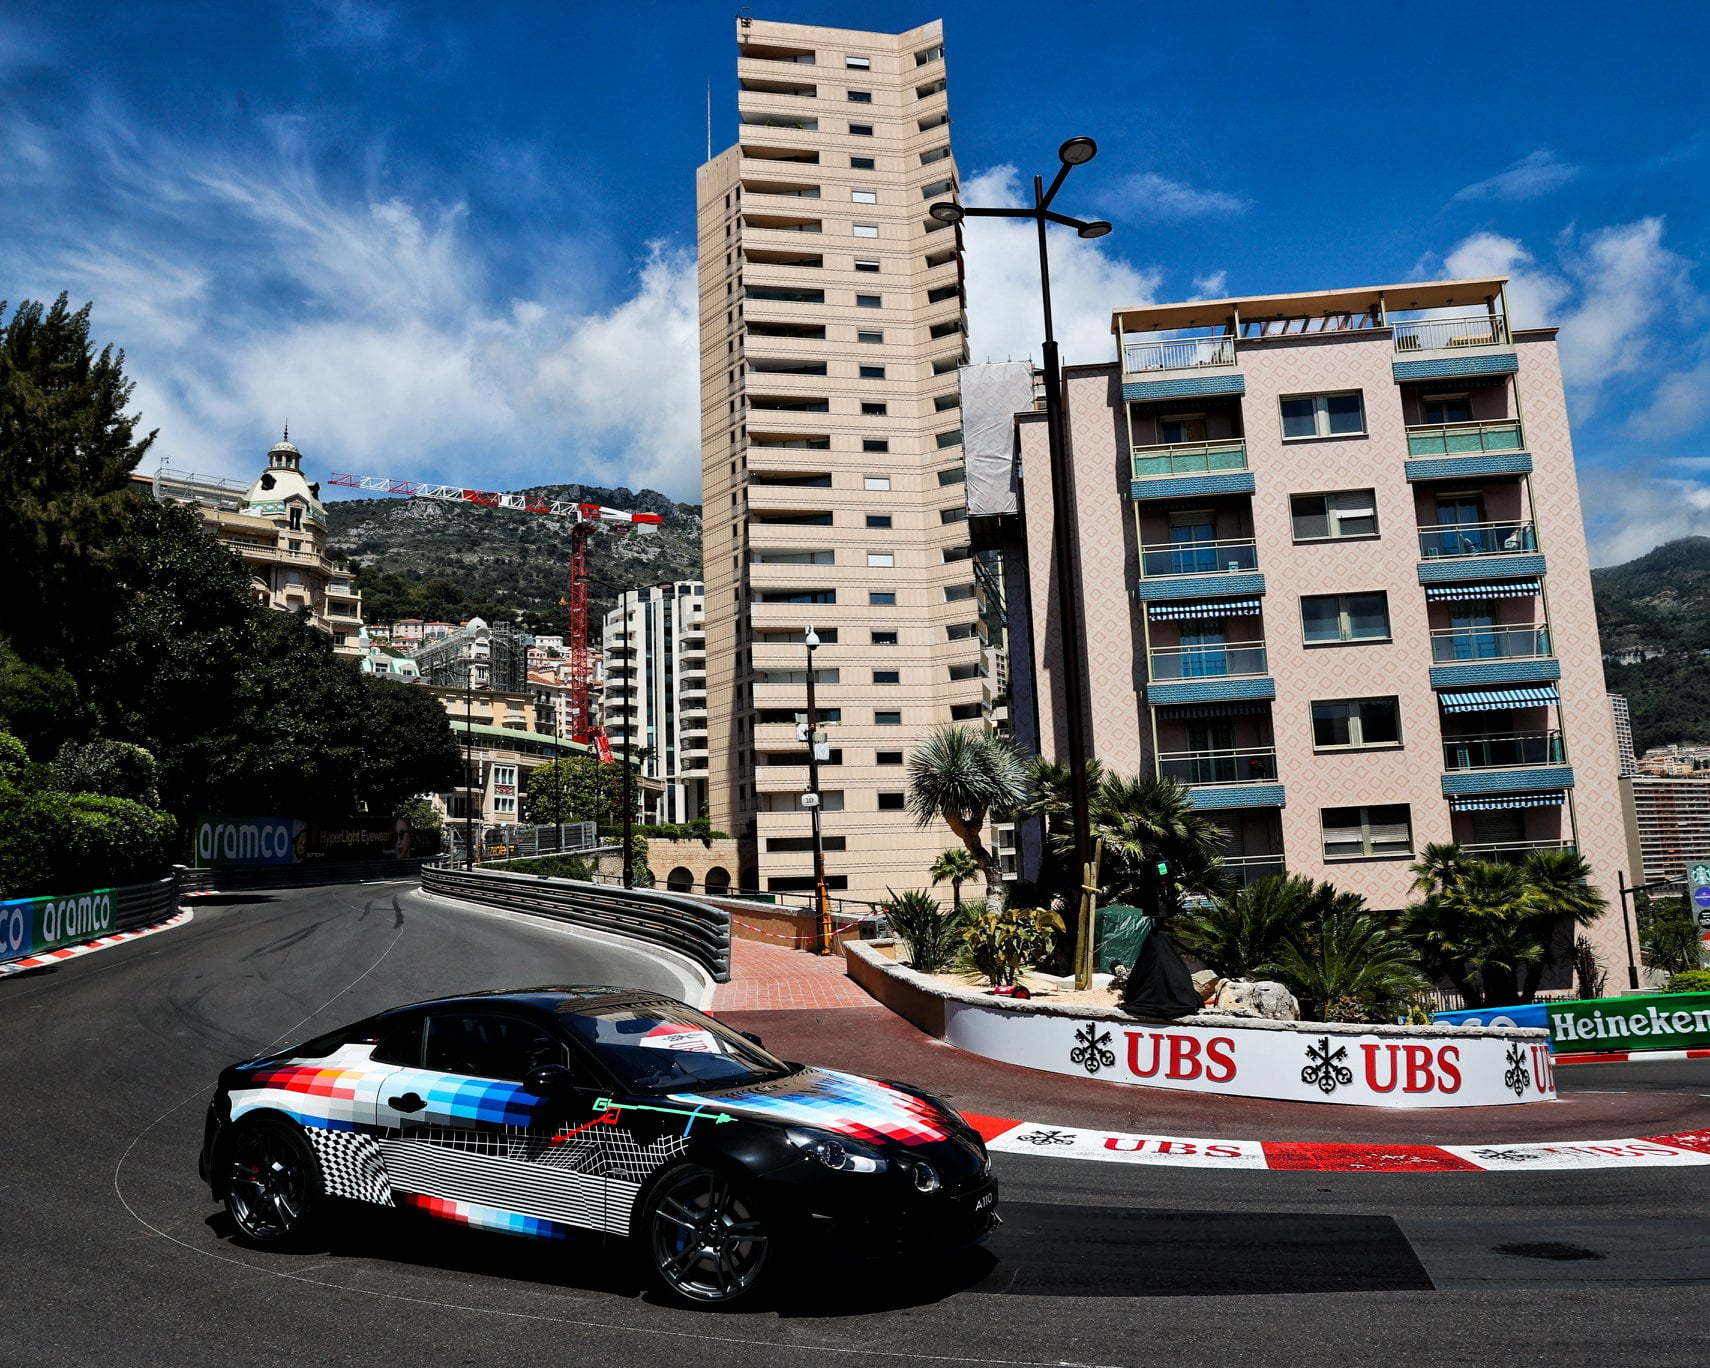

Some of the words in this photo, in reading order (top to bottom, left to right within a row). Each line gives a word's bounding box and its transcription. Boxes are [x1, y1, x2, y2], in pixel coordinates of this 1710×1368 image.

[199, 821, 289, 860] aramco
[43, 894, 111, 942] aramco
[1124, 1030, 1238, 1084] UBS
[1361, 1043, 1463, 1095] UBS
[1104, 1136, 1242, 1158] UBS
